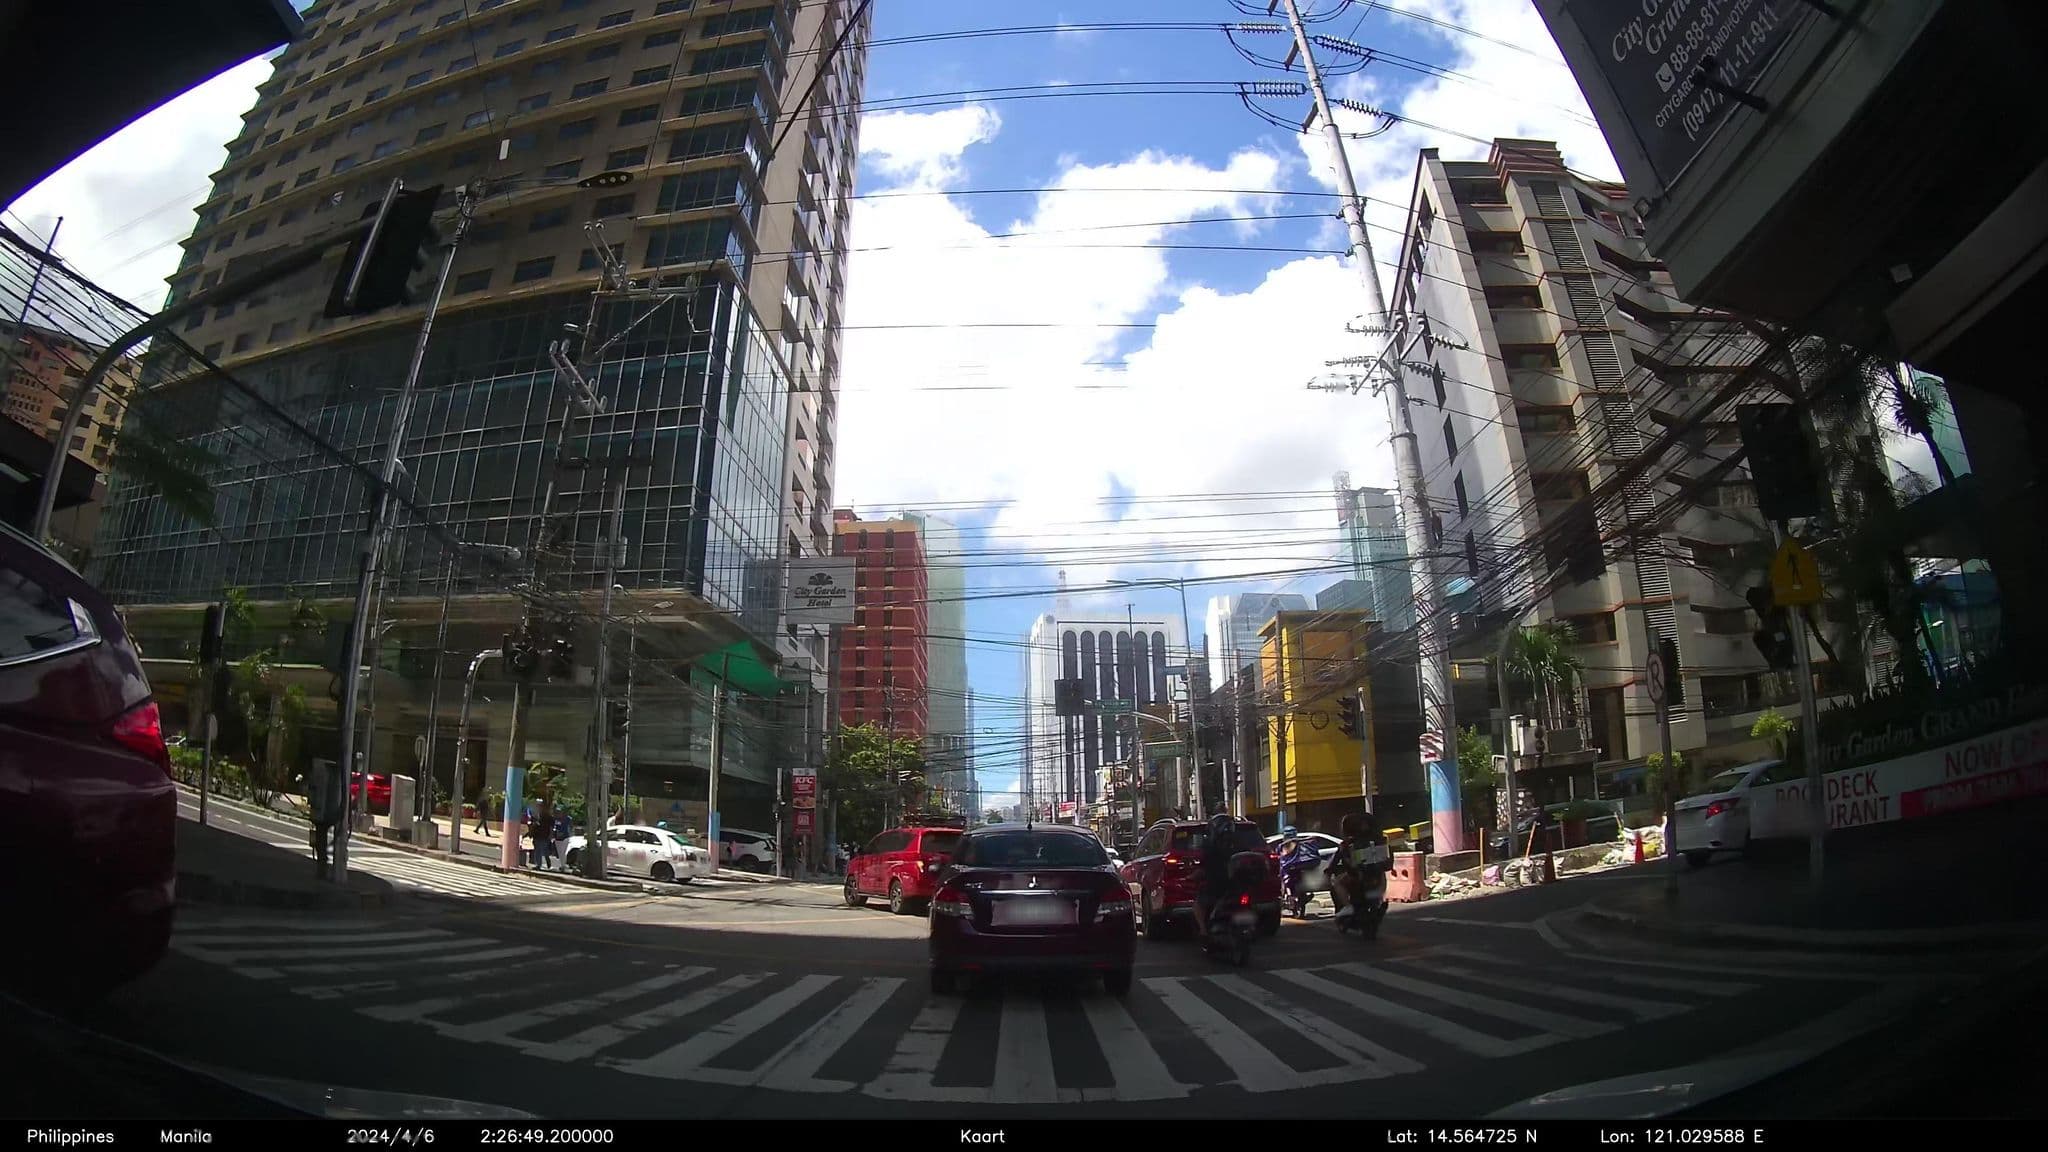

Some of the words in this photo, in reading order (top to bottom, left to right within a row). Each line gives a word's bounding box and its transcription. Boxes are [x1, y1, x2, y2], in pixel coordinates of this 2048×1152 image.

[1612, 16, 1643, 62] City
[1645, 0, 1691, 55] Gran
[1669, 0, 1729, 73] 88-88-81-
[794, 586, 813, 597] City
[814, 586, 847, 596] Garden
[806, 598, 833, 608] Hotel
[1945, 737, 2002, 778] NOW
[794, 776, 814, 784] KFC
